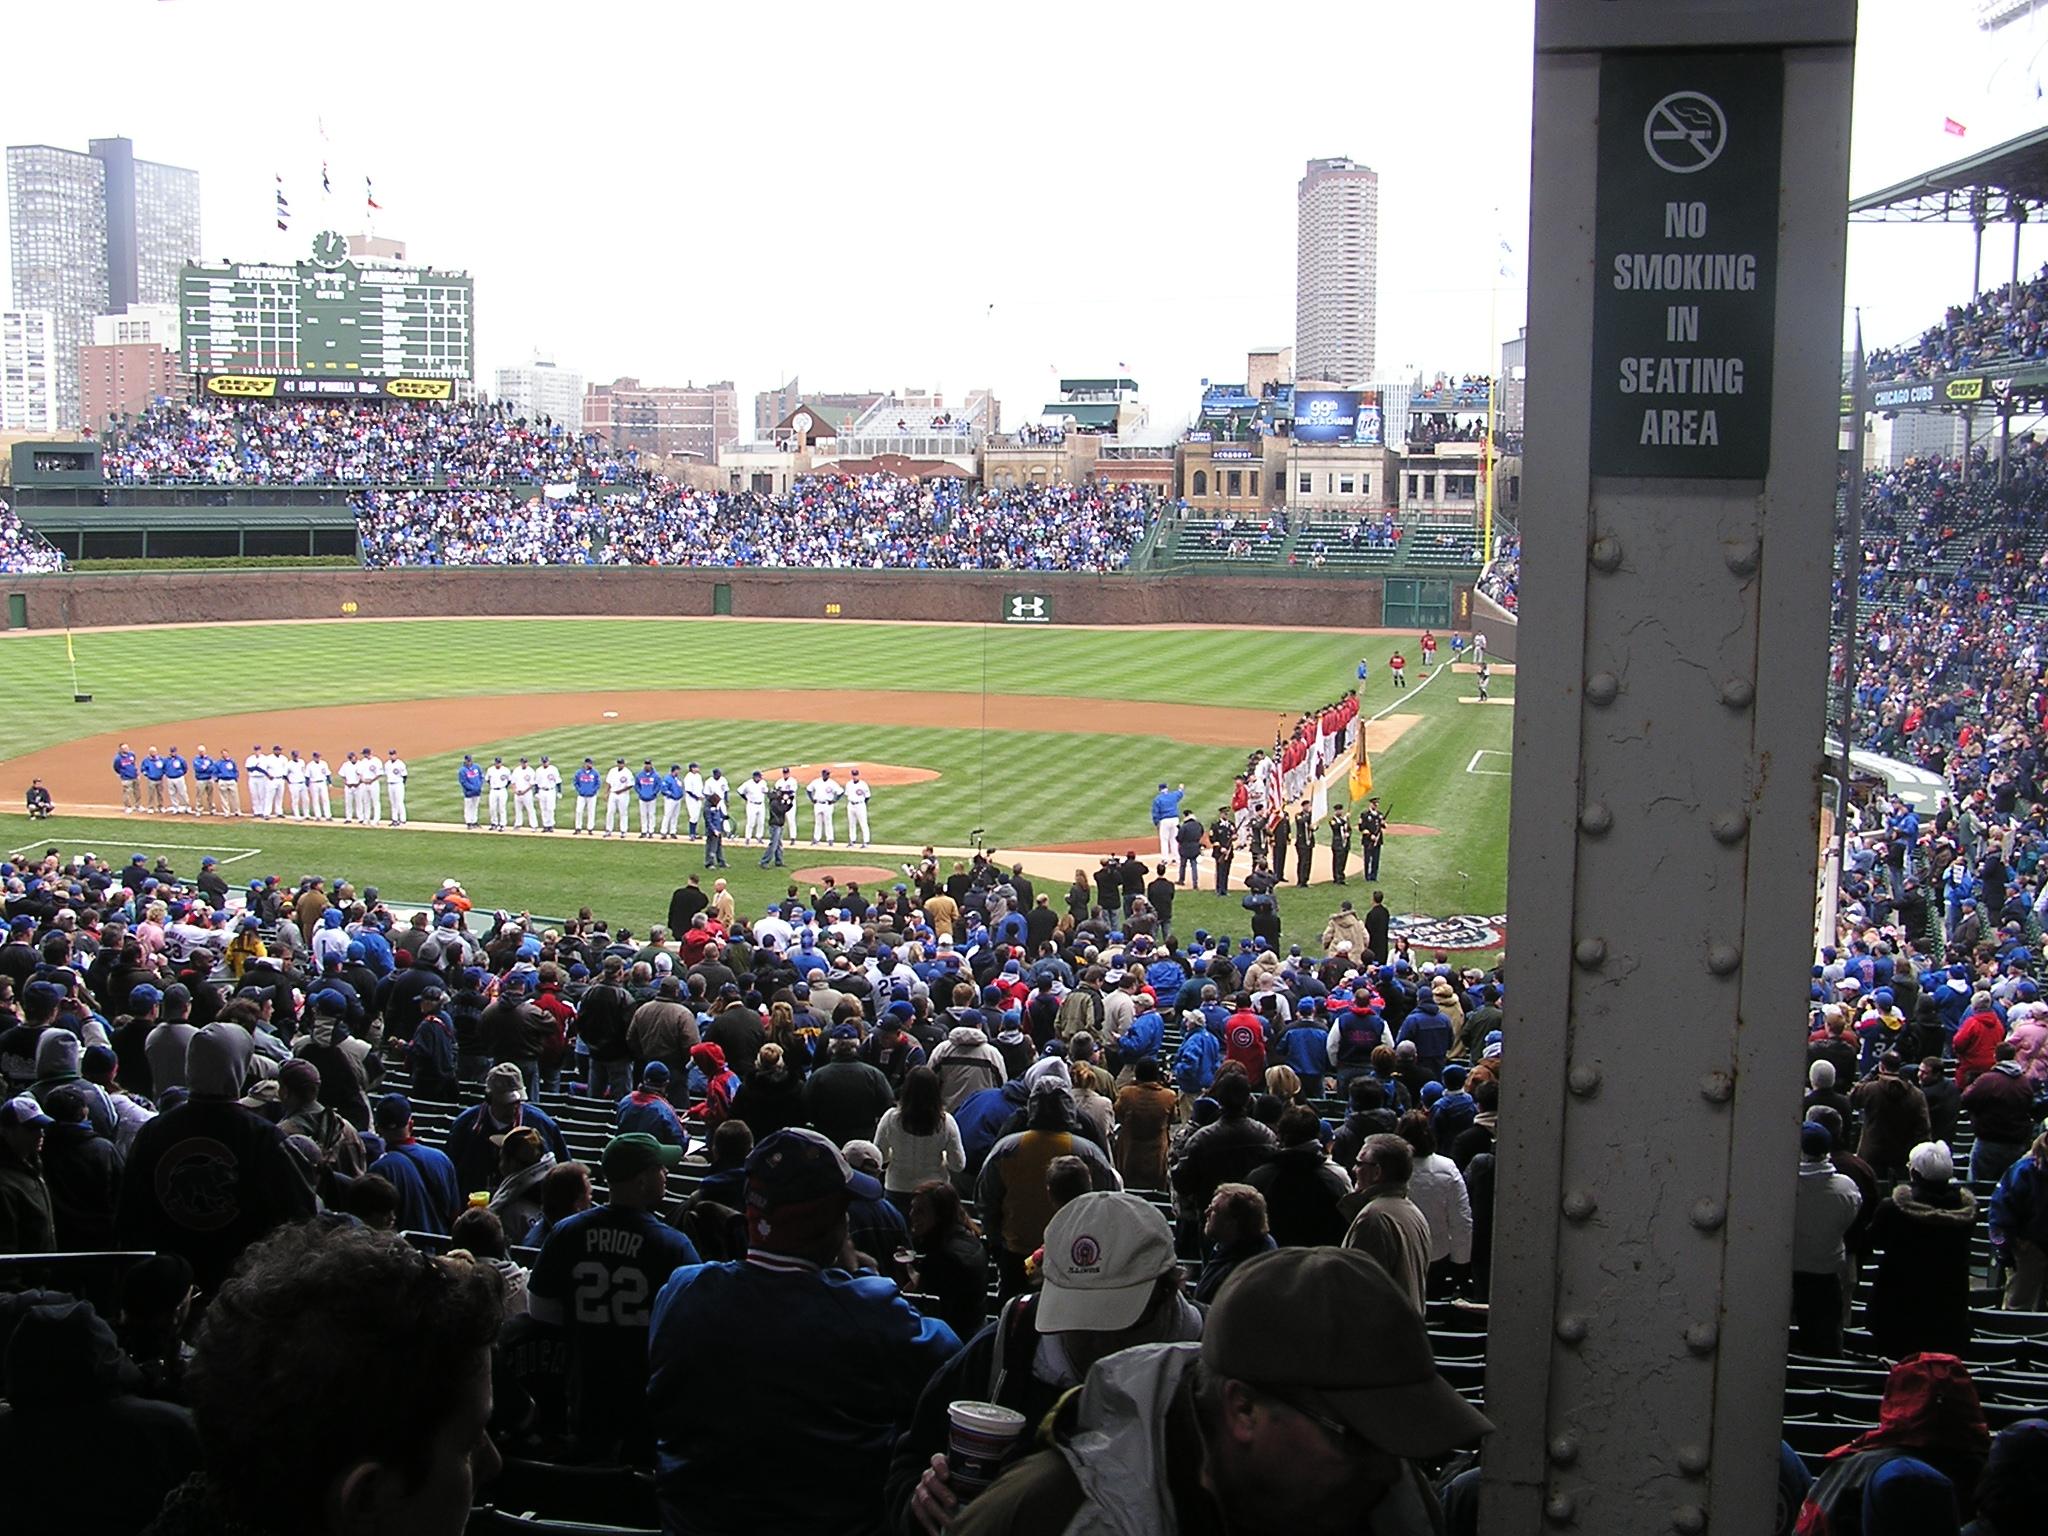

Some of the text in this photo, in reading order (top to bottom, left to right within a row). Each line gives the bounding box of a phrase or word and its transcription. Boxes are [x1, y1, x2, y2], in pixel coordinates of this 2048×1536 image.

[1665, 202, 1707, 238] NO
[238, 265, 301, 280] NATIONAL
[359, 270, 420, 285] AMERICAN
[1613, 254, 1756, 291] SMOKING
[1667, 306, 1698, 342] IN
[1619, 358, 1744, 395] SEATING
[1310, 399, 1338, 417] 99th
[1874, 389, 1910, 406] CHICAGO
[1911, 385, 1934, 402] CUBS
[1640, 409, 1719, 446] AREA
[586, 1228, 644, 1258] PRIOR
[572, 1261, 650, 1326] 22
